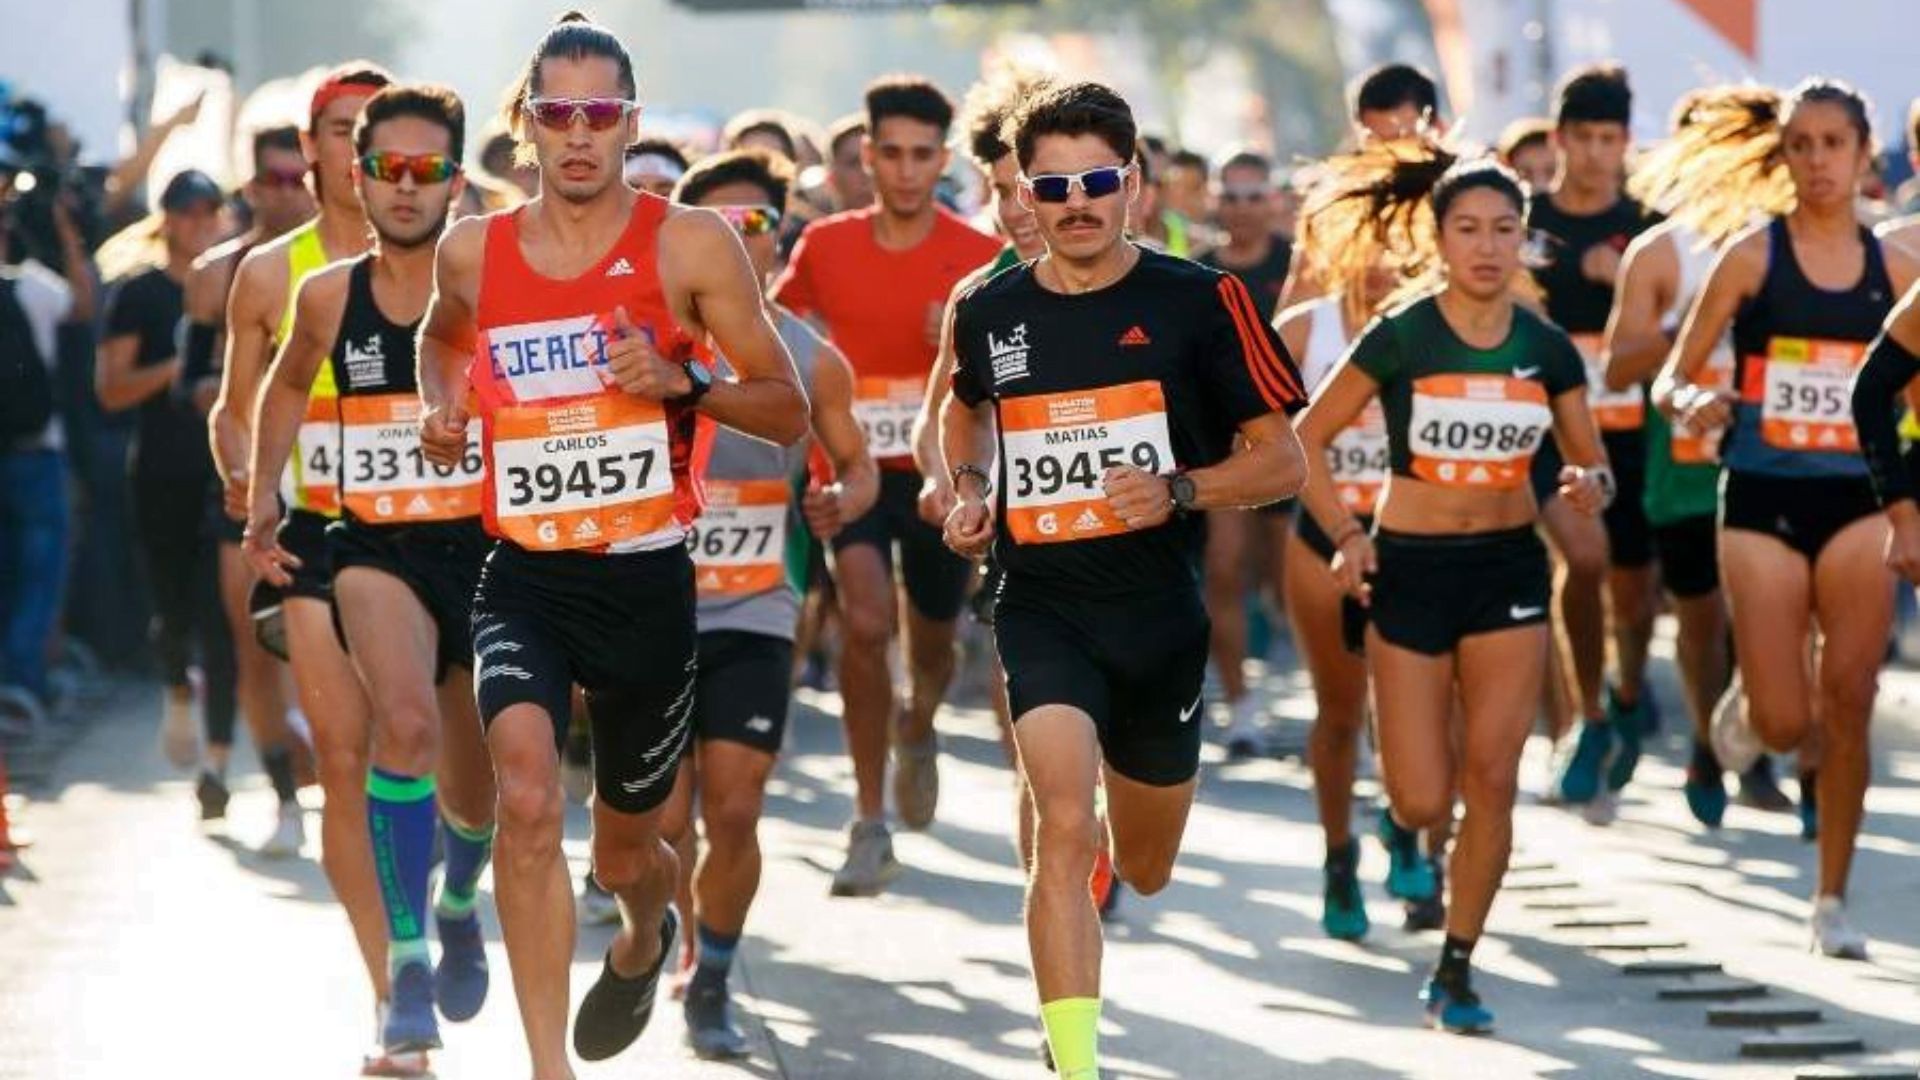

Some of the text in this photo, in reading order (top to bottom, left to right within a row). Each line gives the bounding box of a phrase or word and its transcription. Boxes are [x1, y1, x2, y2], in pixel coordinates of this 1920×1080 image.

[489, 325, 655, 379] EJERCI
[543, 434, 607, 454] CARLOS
[1045, 426, 1108, 445] MATIAS
[1419, 420, 1540, 451] 40986
[507, 448, 656, 507] 39457
